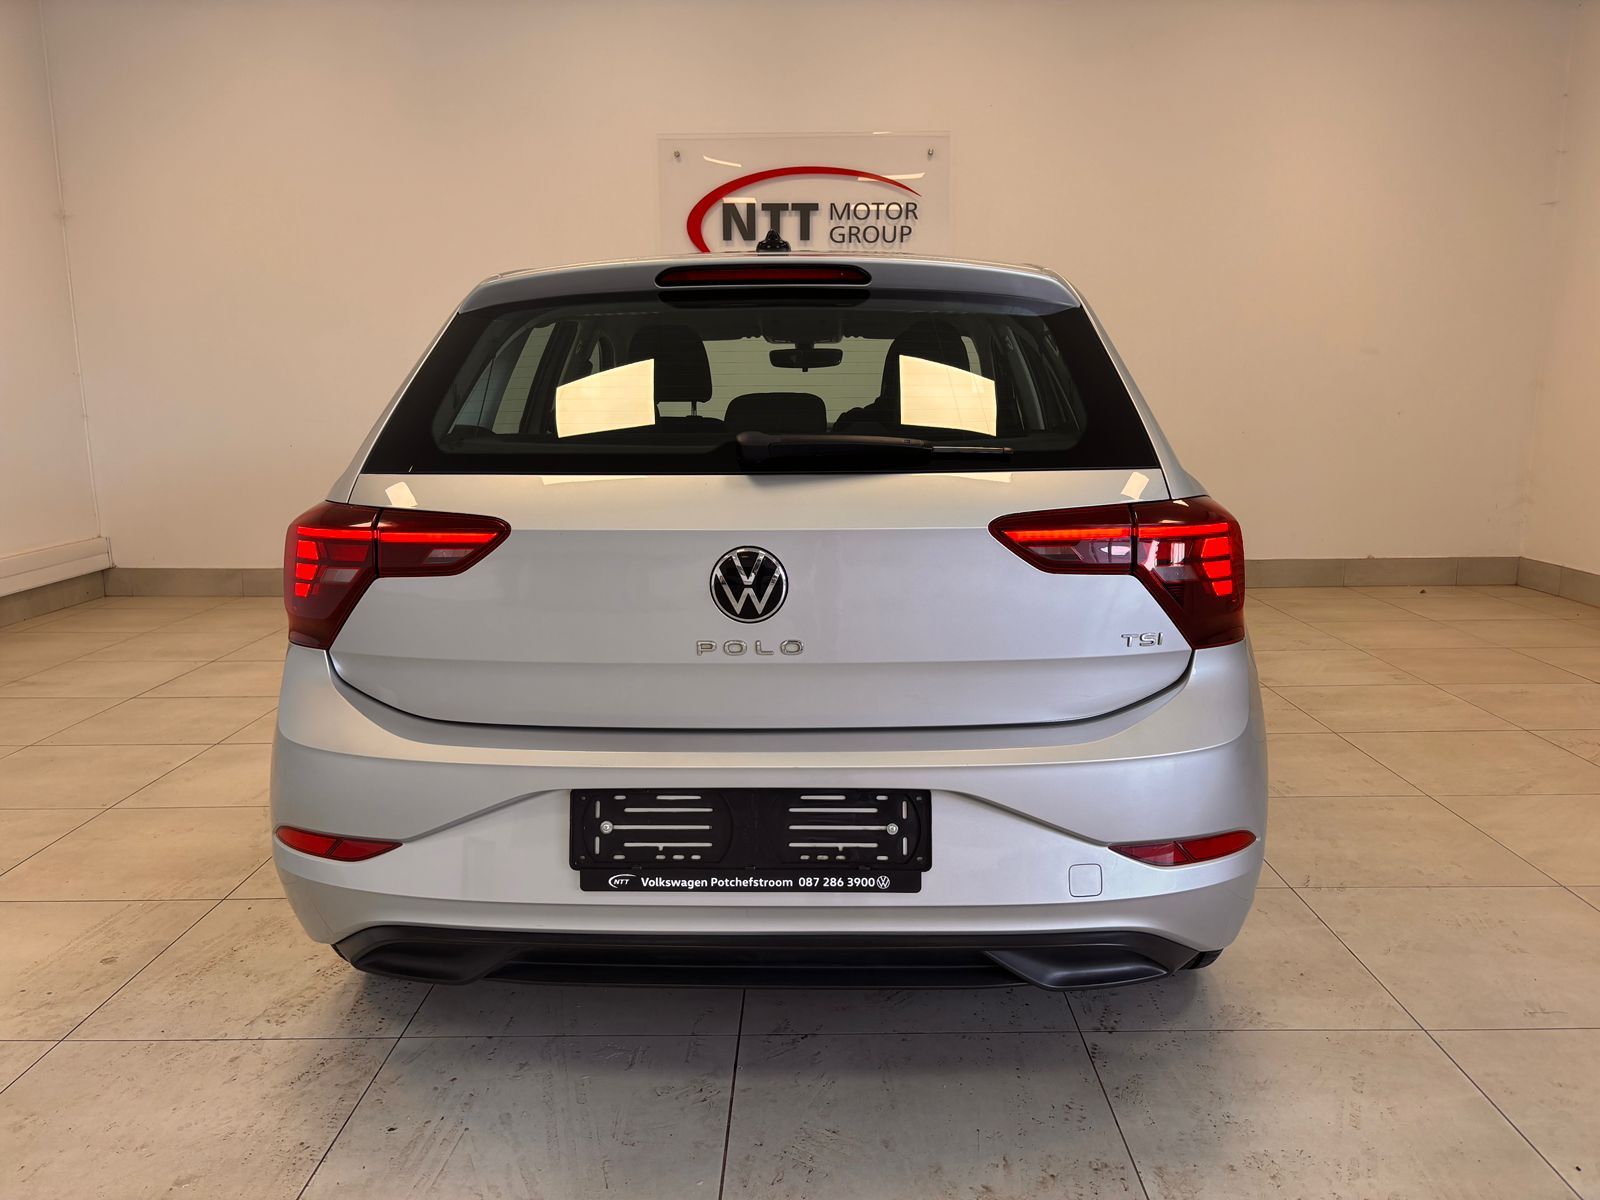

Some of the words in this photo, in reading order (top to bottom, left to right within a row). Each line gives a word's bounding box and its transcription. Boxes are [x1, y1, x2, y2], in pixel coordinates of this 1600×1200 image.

[829, 202, 918, 221] MOTOR
[722, 202, 819, 241] NTT
[829, 225, 912, 243] GROUP
[696, 640, 804, 656] POLO
[1121, 632, 1163, 648] TSI
[641, 877, 708, 889] Volkswagen
[710, 877, 793, 887] Potchefstroom
[799, 877, 820, 887] 087
[823, 877, 844, 887] 286
[847, 877, 876, 887] 3900
